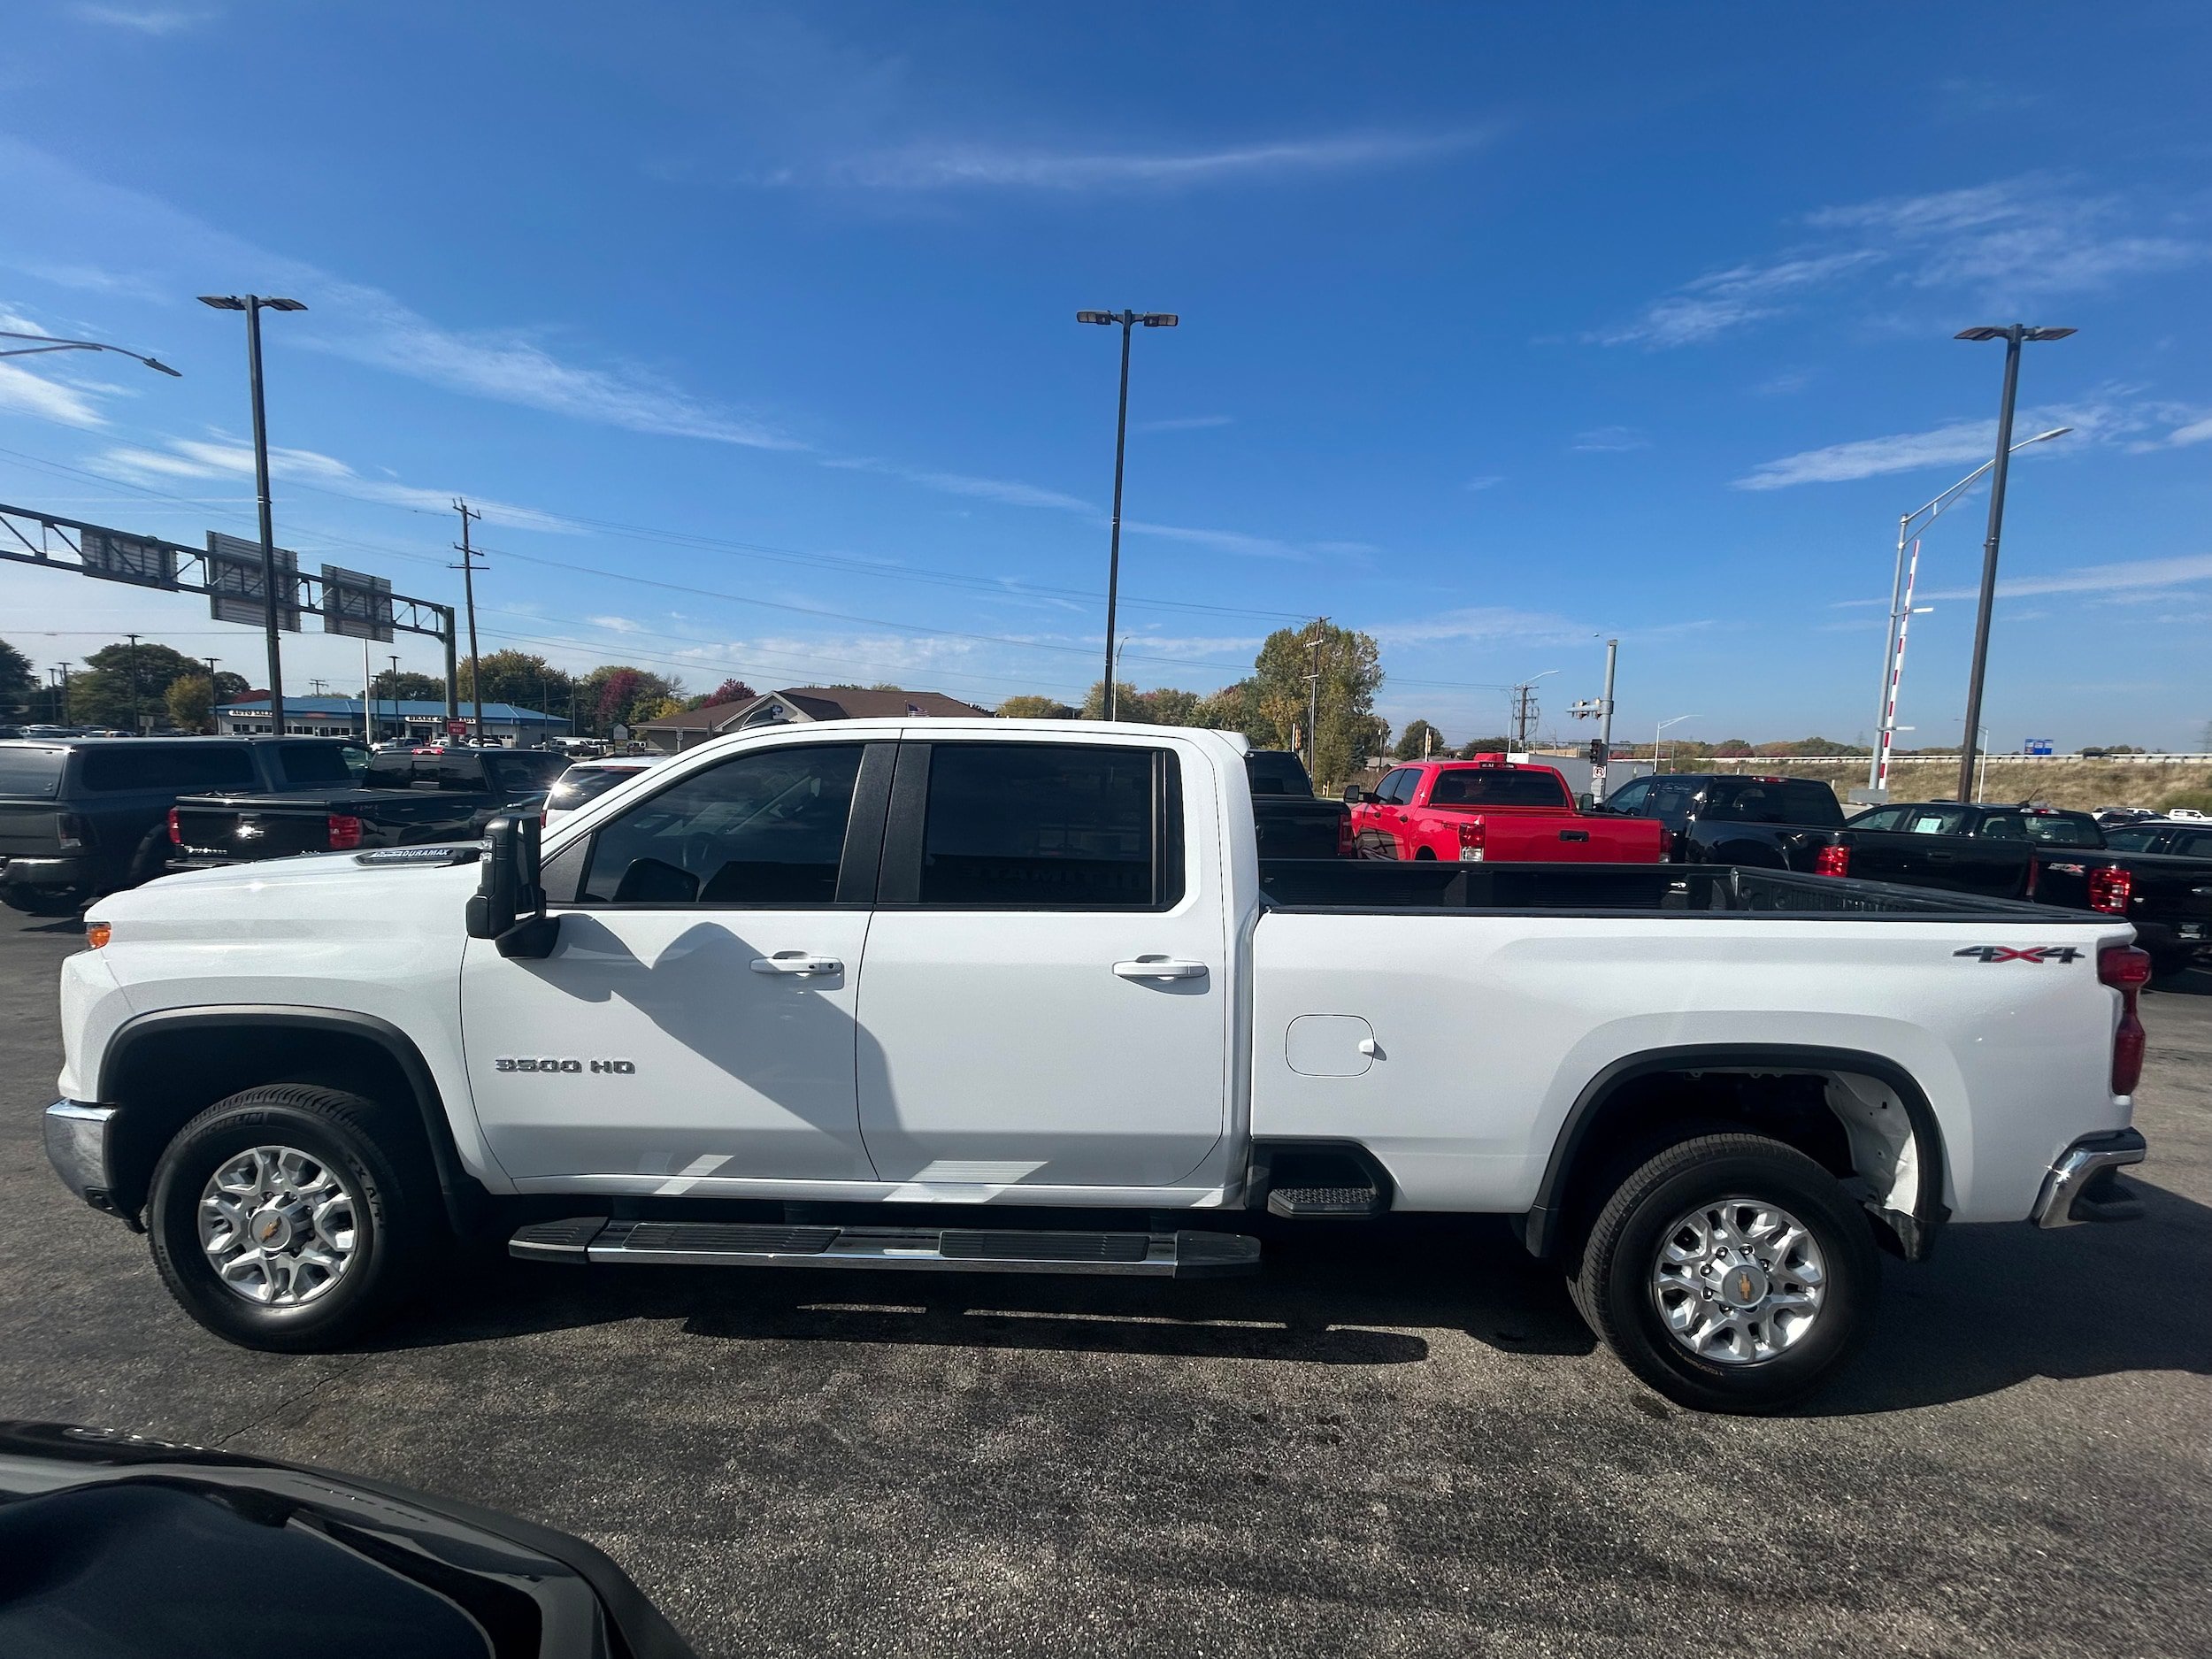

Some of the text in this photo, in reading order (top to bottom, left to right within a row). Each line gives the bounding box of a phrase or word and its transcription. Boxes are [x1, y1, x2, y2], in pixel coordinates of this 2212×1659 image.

[402, 849, 450, 857] DURAMAX
[495, 1058, 636, 1074] 3500 HD
